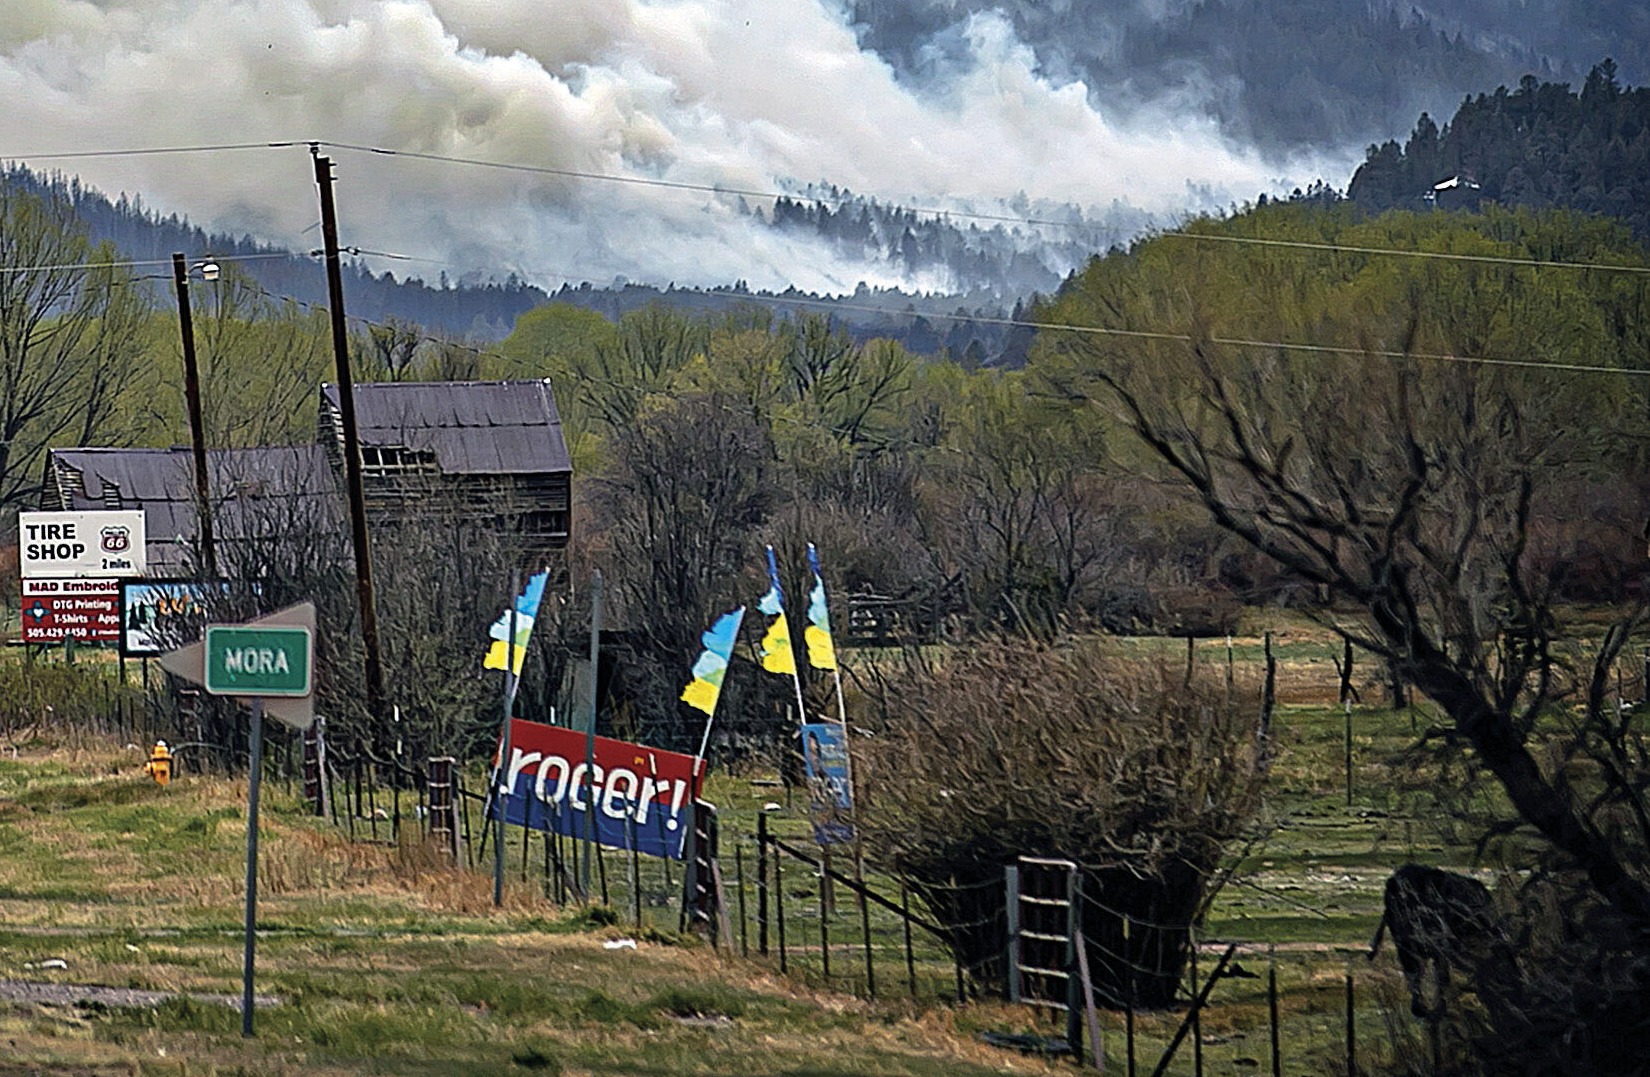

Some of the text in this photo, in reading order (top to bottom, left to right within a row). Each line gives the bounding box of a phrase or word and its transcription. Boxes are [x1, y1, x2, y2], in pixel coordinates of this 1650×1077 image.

[26, 524, 76, 540] TIRE
[106, 537, 125, 548] 66
[27, 544, 85, 560] SHOP
[102, 558, 108, 569] 2
[29, 582, 59, 592] MAD
[53, 599, 112, 612] DTG Printing
[54, 614, 89, 624] T-Shirts
[224, 646, 291, 675] MORA
